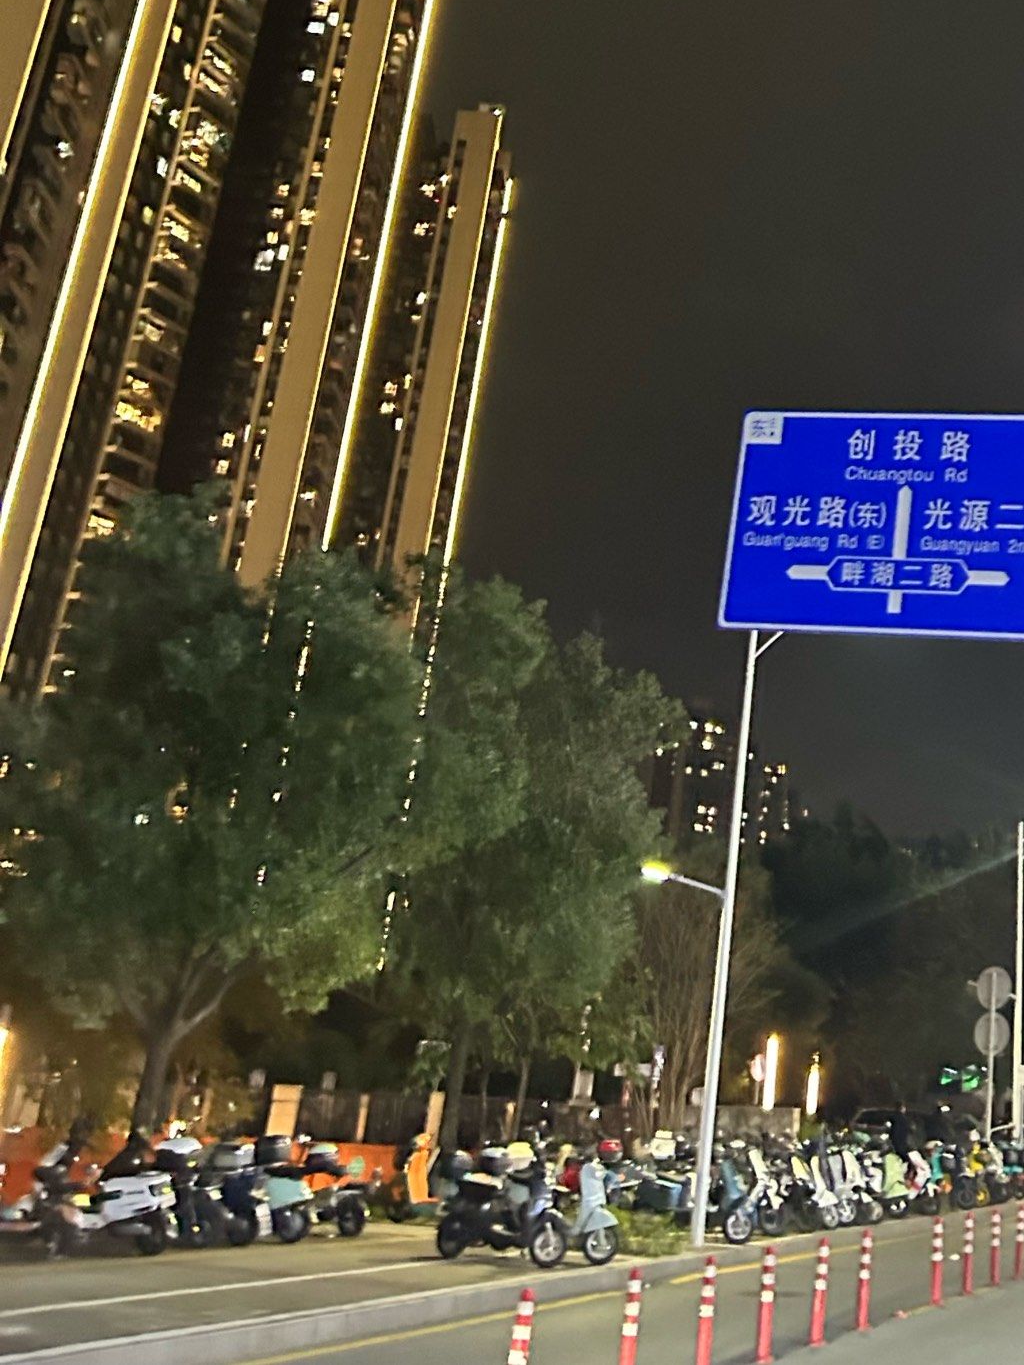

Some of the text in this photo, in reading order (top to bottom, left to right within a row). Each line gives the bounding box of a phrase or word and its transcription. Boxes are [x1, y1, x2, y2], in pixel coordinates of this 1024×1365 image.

[847, 428, 971, 462] 创投路
[845, 465, 969, 485] Chuangtou Rd
[746, 495, 887, 529] 观光路(东)
[836, 533, 859, 549] Rd
[920, 535, 1000, 555] Guangyuan
